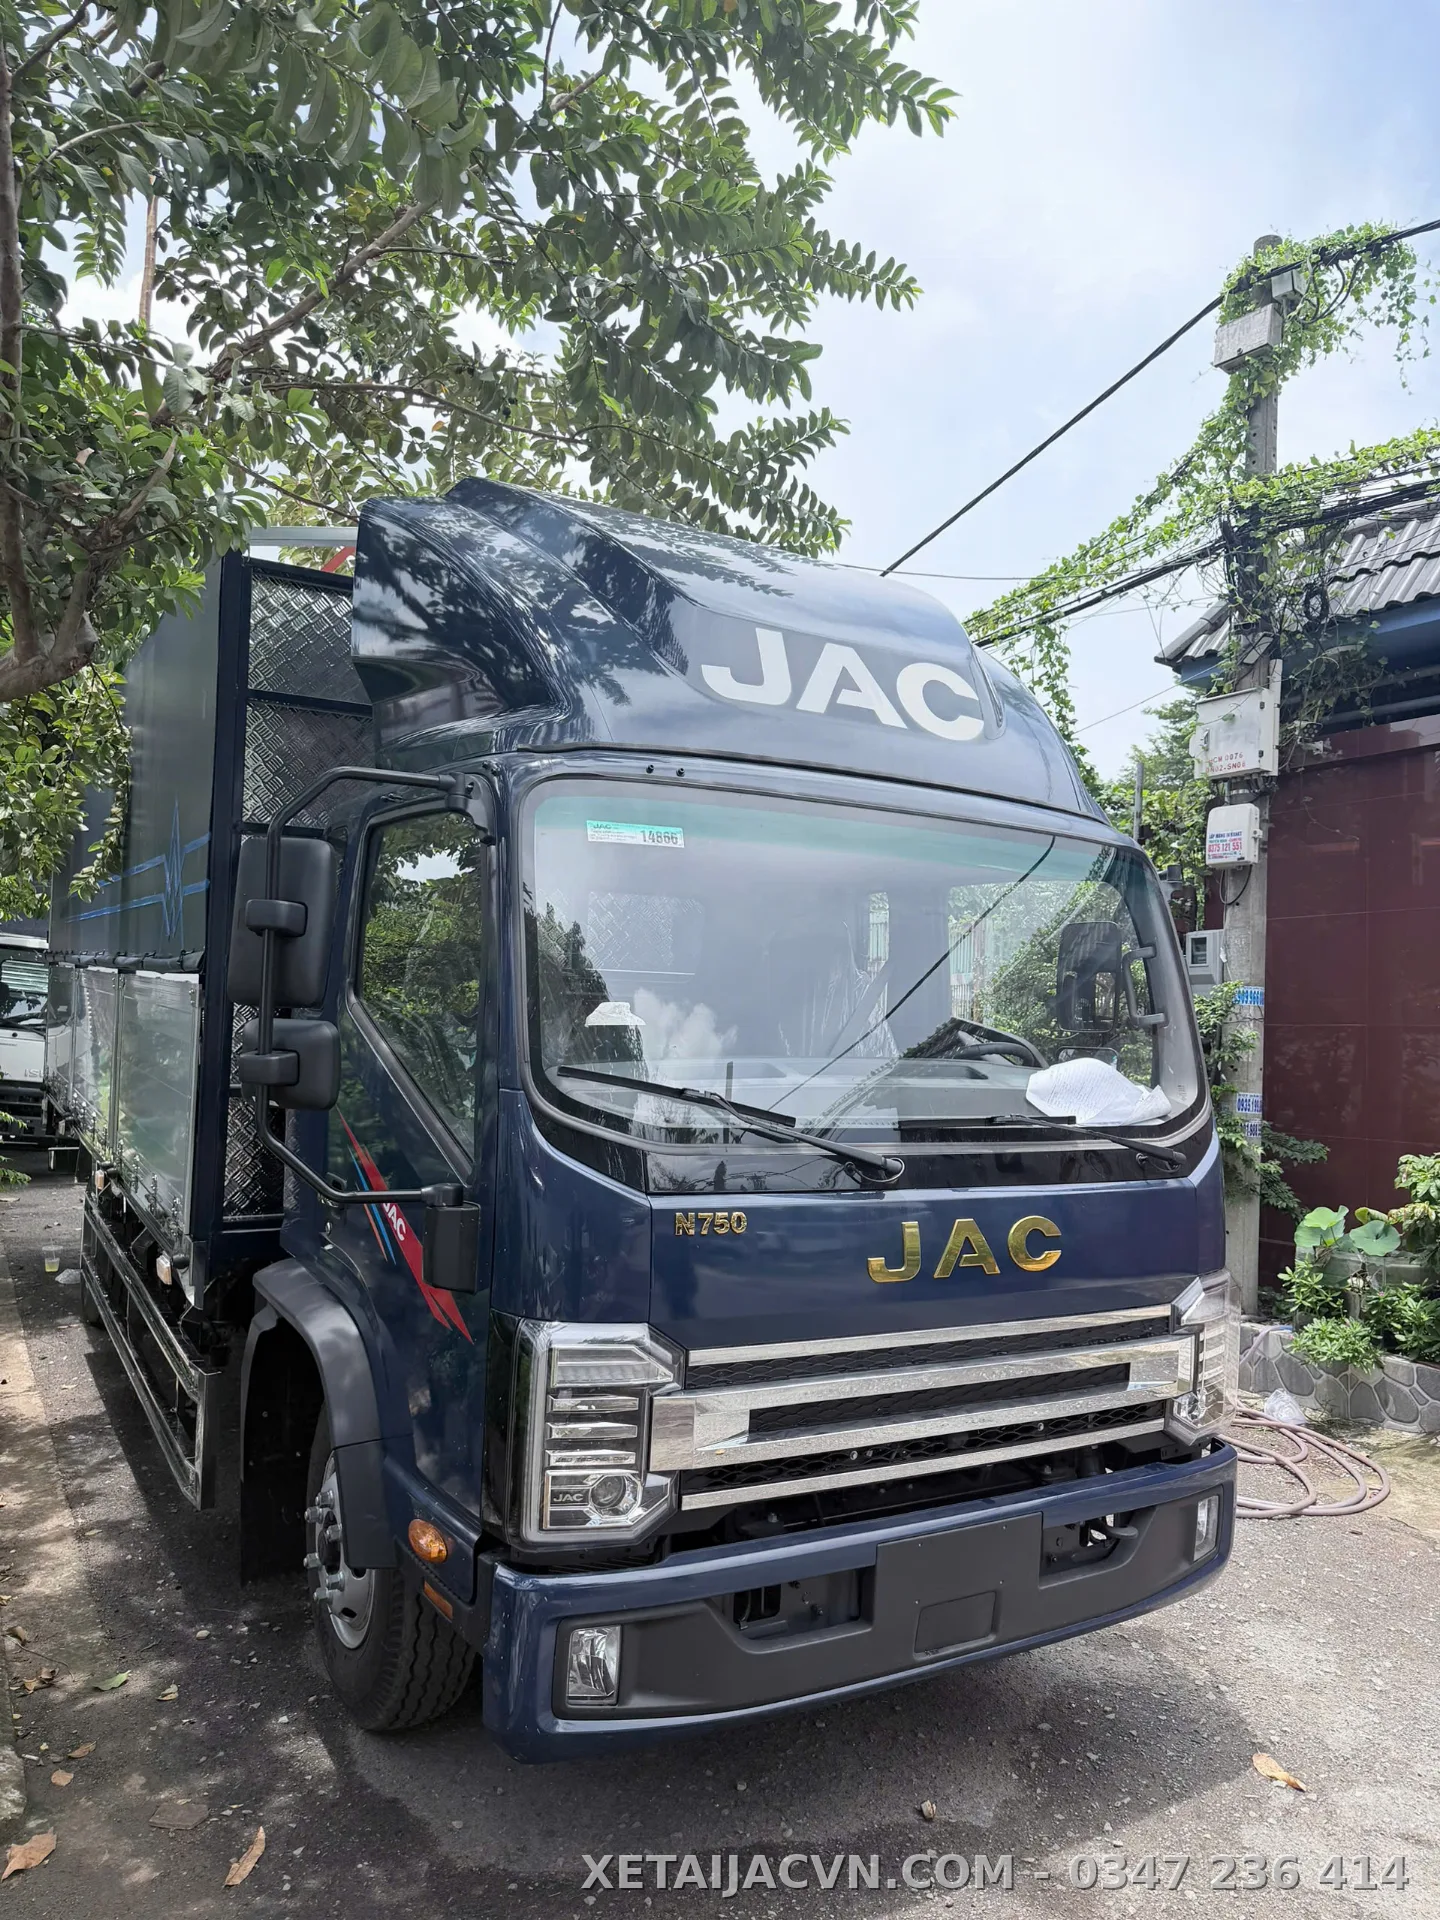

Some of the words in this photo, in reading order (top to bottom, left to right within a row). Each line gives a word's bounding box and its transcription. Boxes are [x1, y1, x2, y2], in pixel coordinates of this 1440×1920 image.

[701, 627, 985, 741] JAC
[674, 1211, 747, 1236] N750
[866, 1215, 1062, 1284] JAC
[553, 1493, 583, 1502] JAC
